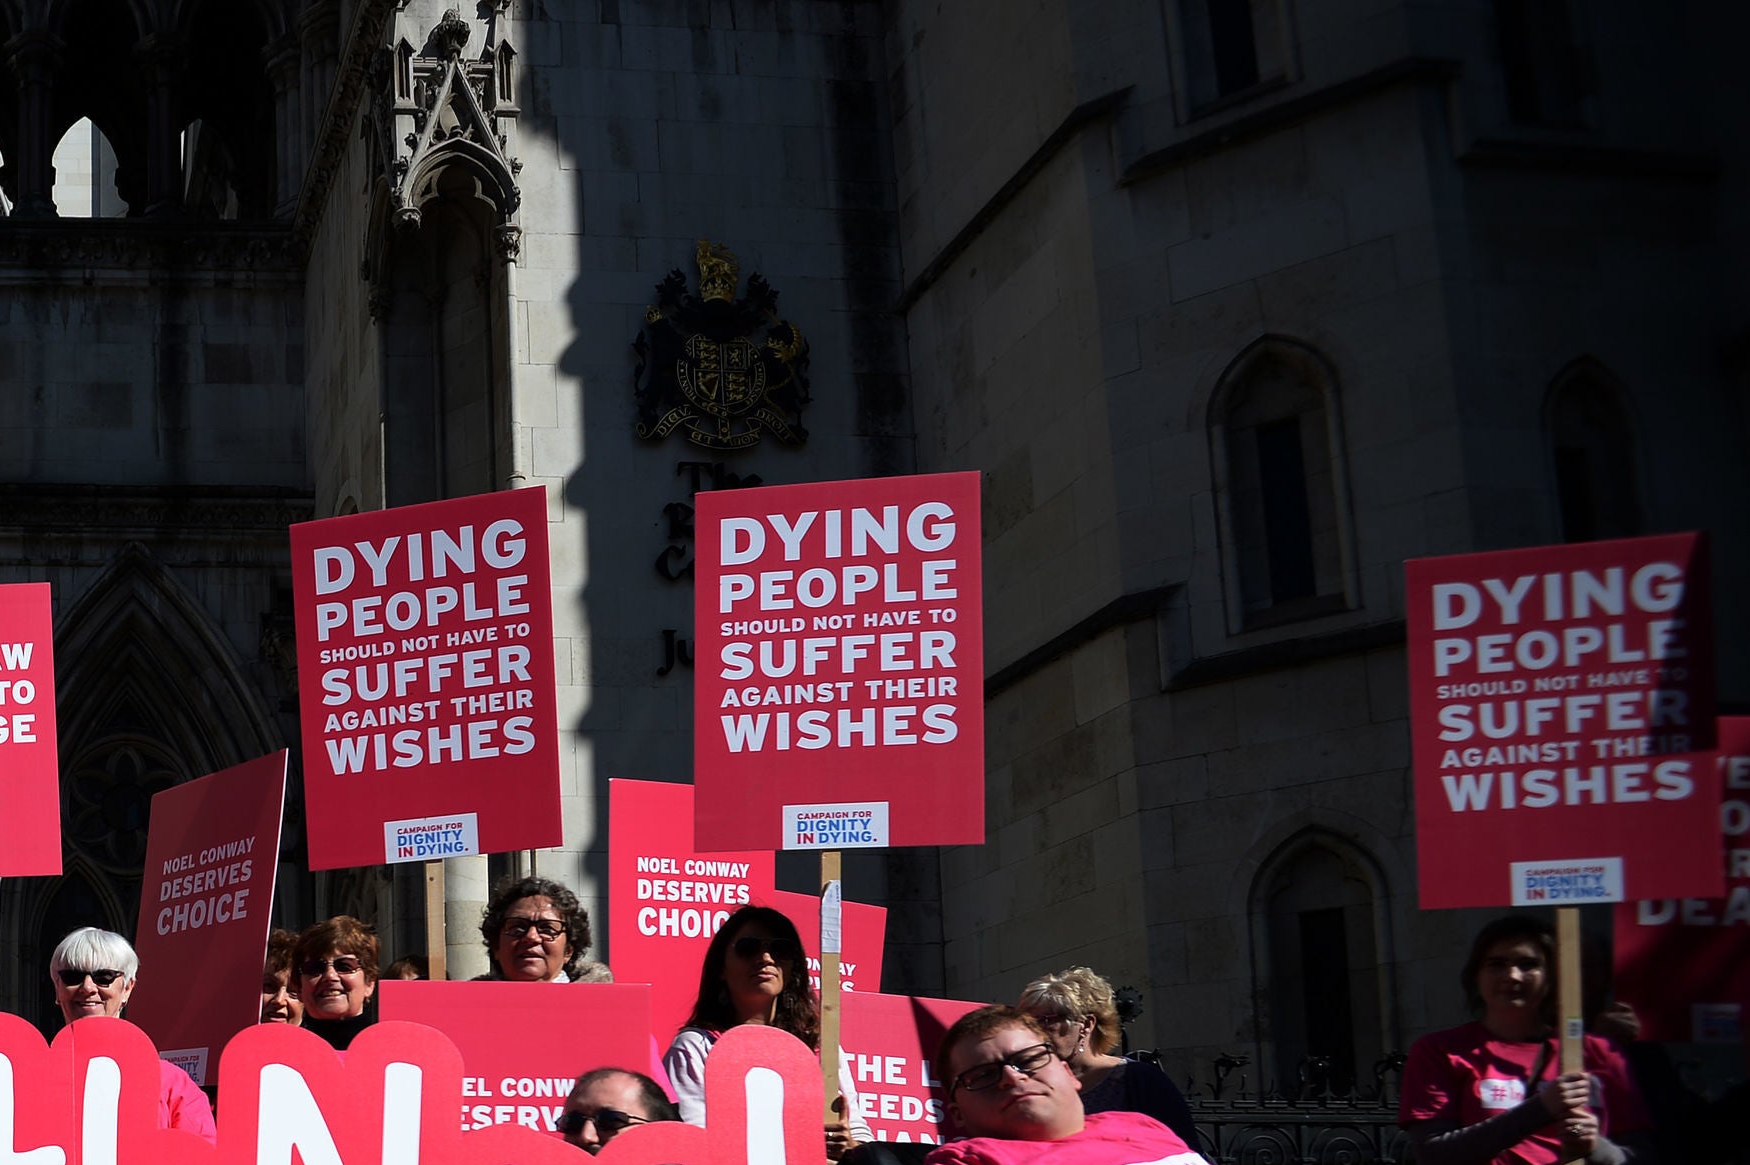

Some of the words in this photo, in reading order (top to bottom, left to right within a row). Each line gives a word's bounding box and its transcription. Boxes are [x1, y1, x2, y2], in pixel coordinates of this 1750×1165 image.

[721, 502, 956, 565] DYING
[314, 519, 526, 595] DYING
[720, 560, 957, 613] PEOPLE
[1433, 562, 1686, 631] DYING
[317, 575, 530, 641] PEOPLE
[721, 618, 805, 636] SHOULD
[814, 614, 856, 630] NOT
[864, 611, 921, 627] HAVE
[929, 608, 957, 623] TO
[320, 642, 395, 663] SHOULD
[402, 635, 439, 652] NOT
[447, 627, 498, 646] HAVE
[505, 623, 530, 638] TO
[720, 631, 956, 680] SUFFER
[1435, 618, 1689, 678] PEOPLE
[322, 645, 531, 705] SUFFER
[721, 682, 853, 707] AGAINST
[865, 677, 957, 699] THEIR
[1438, 680, 1527, 700] SHOULD
[1536, 674, 1581, 692] NOT
[1589, 670, 1651, 688] HAVE
[324, 701, 440, 732] AGAINST
[451, 689, 533, 716] THEIR
[721, 704, 958, 752] WISHES
[1438, 689, 1690, 743] SUFFER
[325, 716, 535, 775] WISHES
[1441, 741, 1581, 769] AGAINST
[1441, 760, 1695, 813] WISHES
[396, 824, 442, 835] CAMPAIGN
[445, 822, 461, 830] FOR
[797, 811, 849, 819] CAMPAIGN
[797, 819, 869, 831] DIGNITY
[163, 855, 195, 875] NOEL
[200, 837, 254, 865] CONWAY
[397, 830, 461, 846] DIGNITY
[398, 846, 412, 857] IN
[416, 841, 467, 856] DYING.
[797, 833, 813, 844] IN
[818, 831, 877, 843] DYING.
[160, 860, 252, 901] DESERVES
[637, 857, 680, 874] NOEL
[684, 859, 750, 878] CONWAY
[1526, 875, 1603, 888] DIGNITY
[637, 879, 750, 904] DESERVES
[1527, 889, 1544, 900] IN
[157, 889, 249, 935] CHOICE
[461, 1077, 492, 1097] EL
[500, 1077, 576, 1098] CONW
[858, 1092, 945, 1124] EEDS
